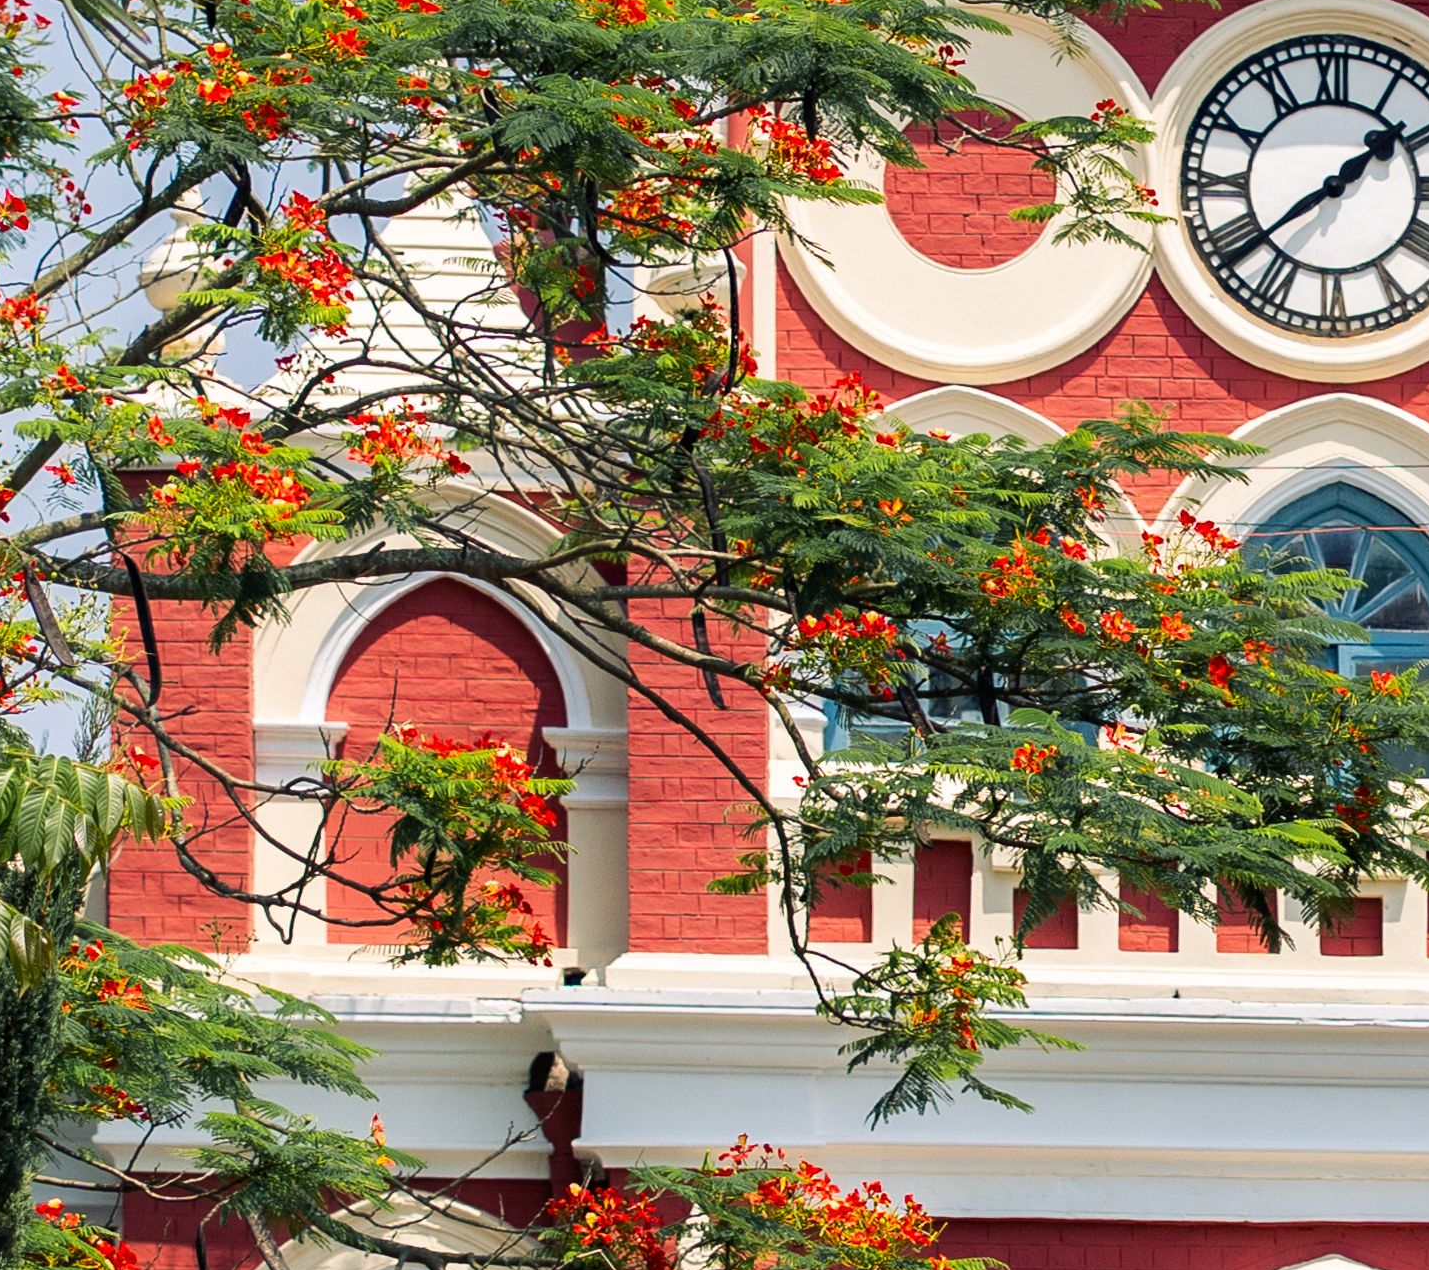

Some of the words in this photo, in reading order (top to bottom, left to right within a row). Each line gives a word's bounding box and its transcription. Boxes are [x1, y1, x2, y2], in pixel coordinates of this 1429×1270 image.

[1253, 66, 1301, 118] XI
[1315, 53, 1349, 104] XII
[1374, 73, 1401, 113] I
[1210, 109, 1264, 150] X
[1199, 169, 1249, 198] IX
[1254, 254, 1299, 307] VII
[1320, 274, 1348, 318] VI
[1374, 261, 1411, 304] V
